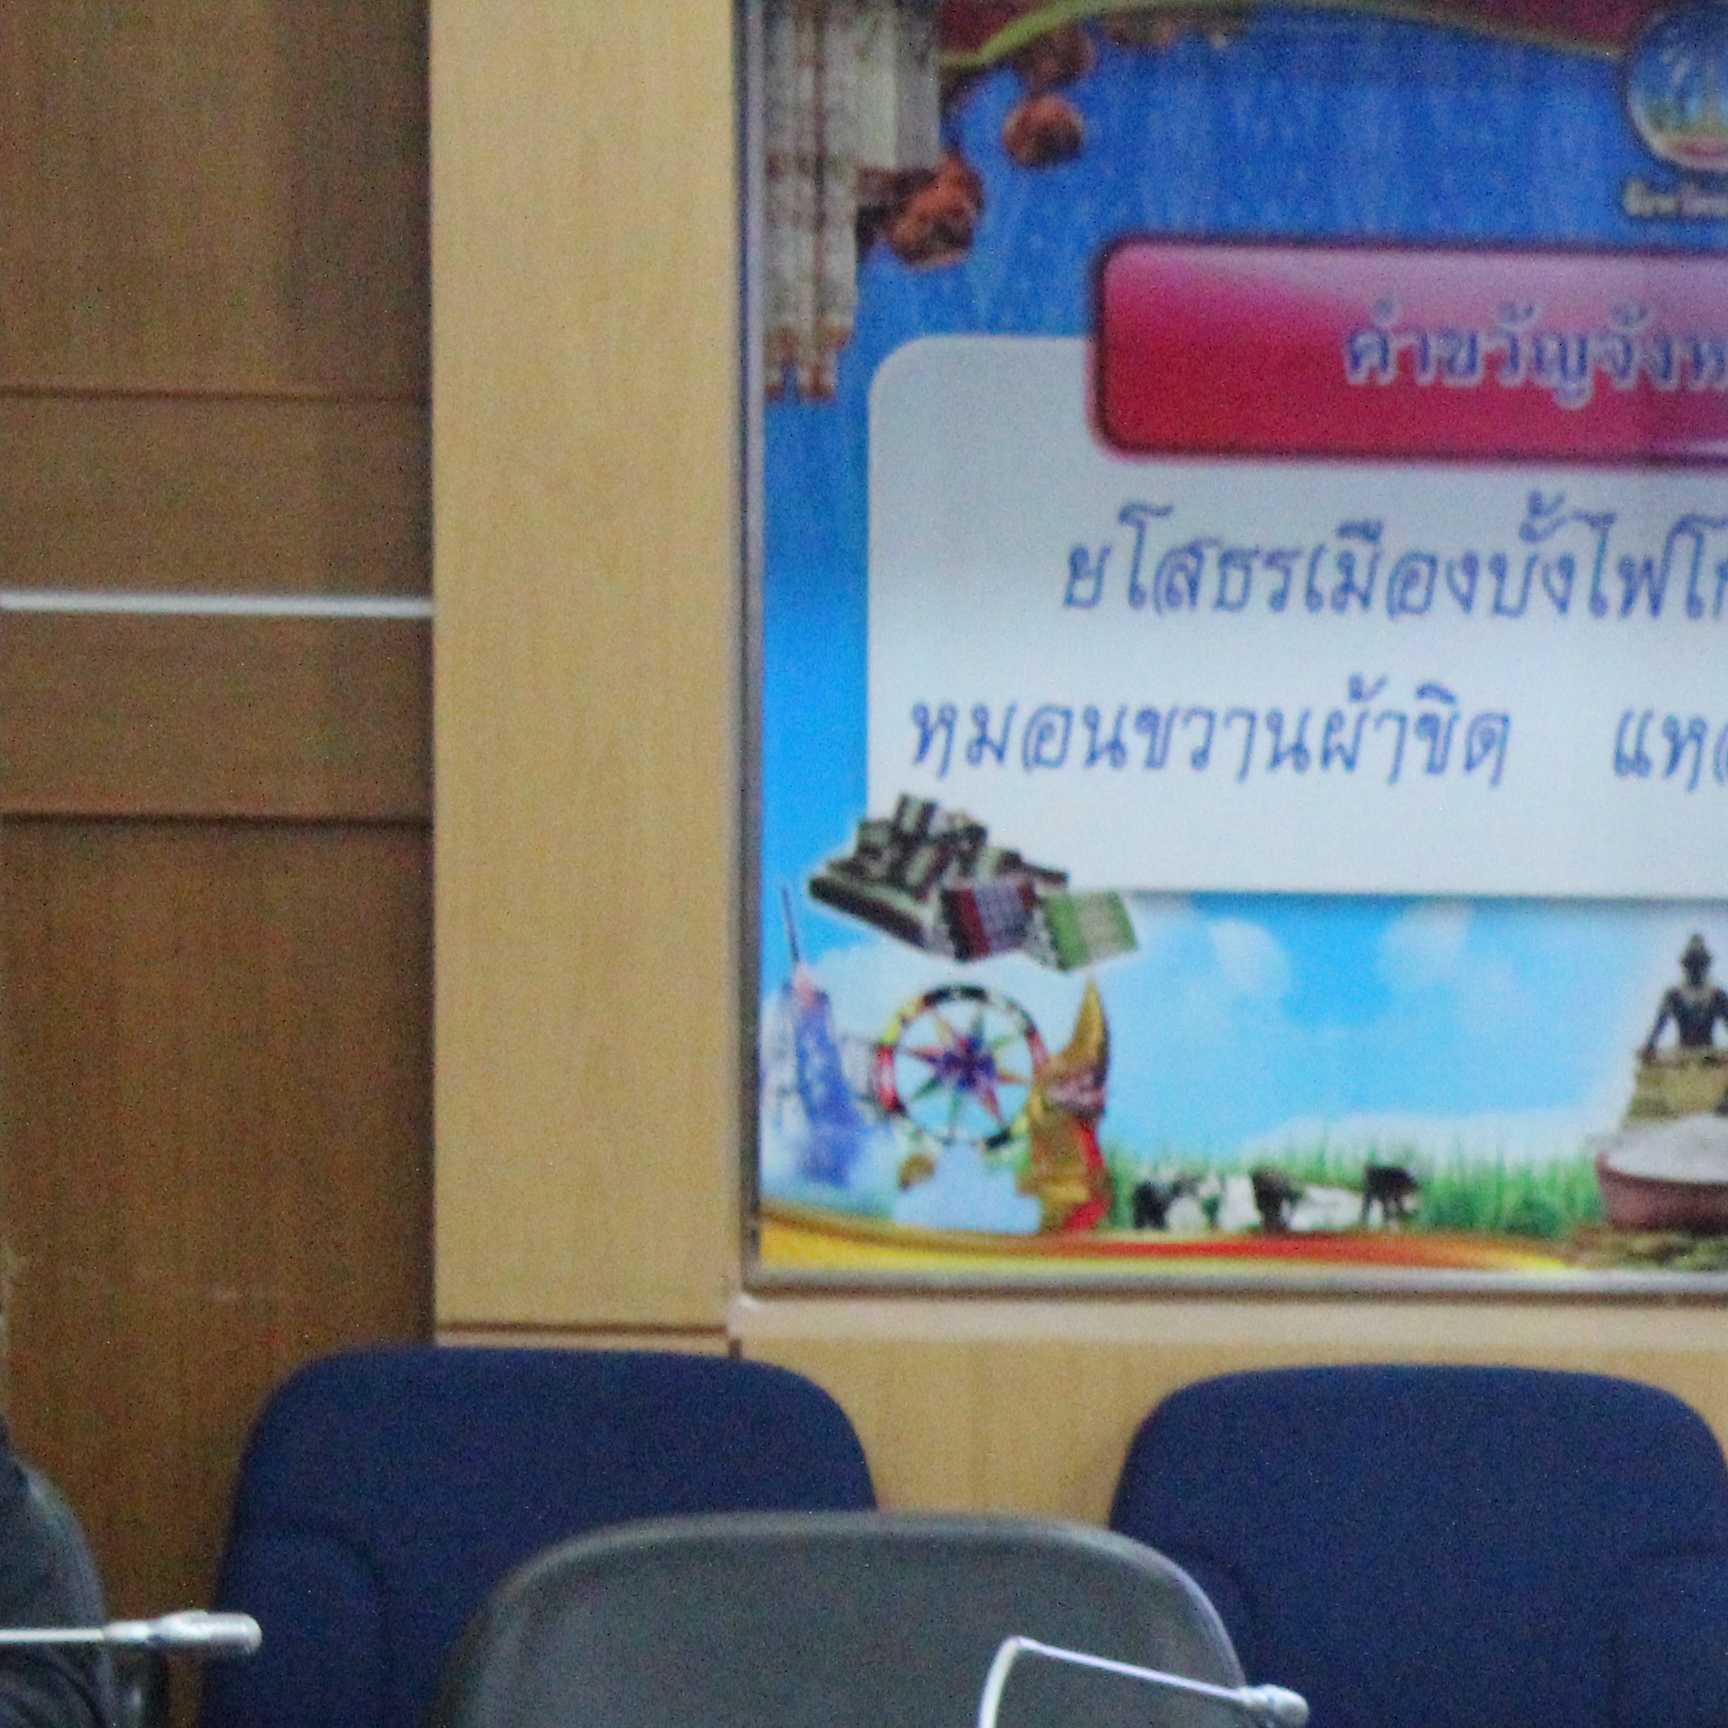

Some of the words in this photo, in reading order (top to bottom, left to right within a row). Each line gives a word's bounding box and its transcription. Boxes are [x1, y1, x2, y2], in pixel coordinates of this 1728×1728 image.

[910, 672, 1513, 787] หมอนขวานผ้าขิด
